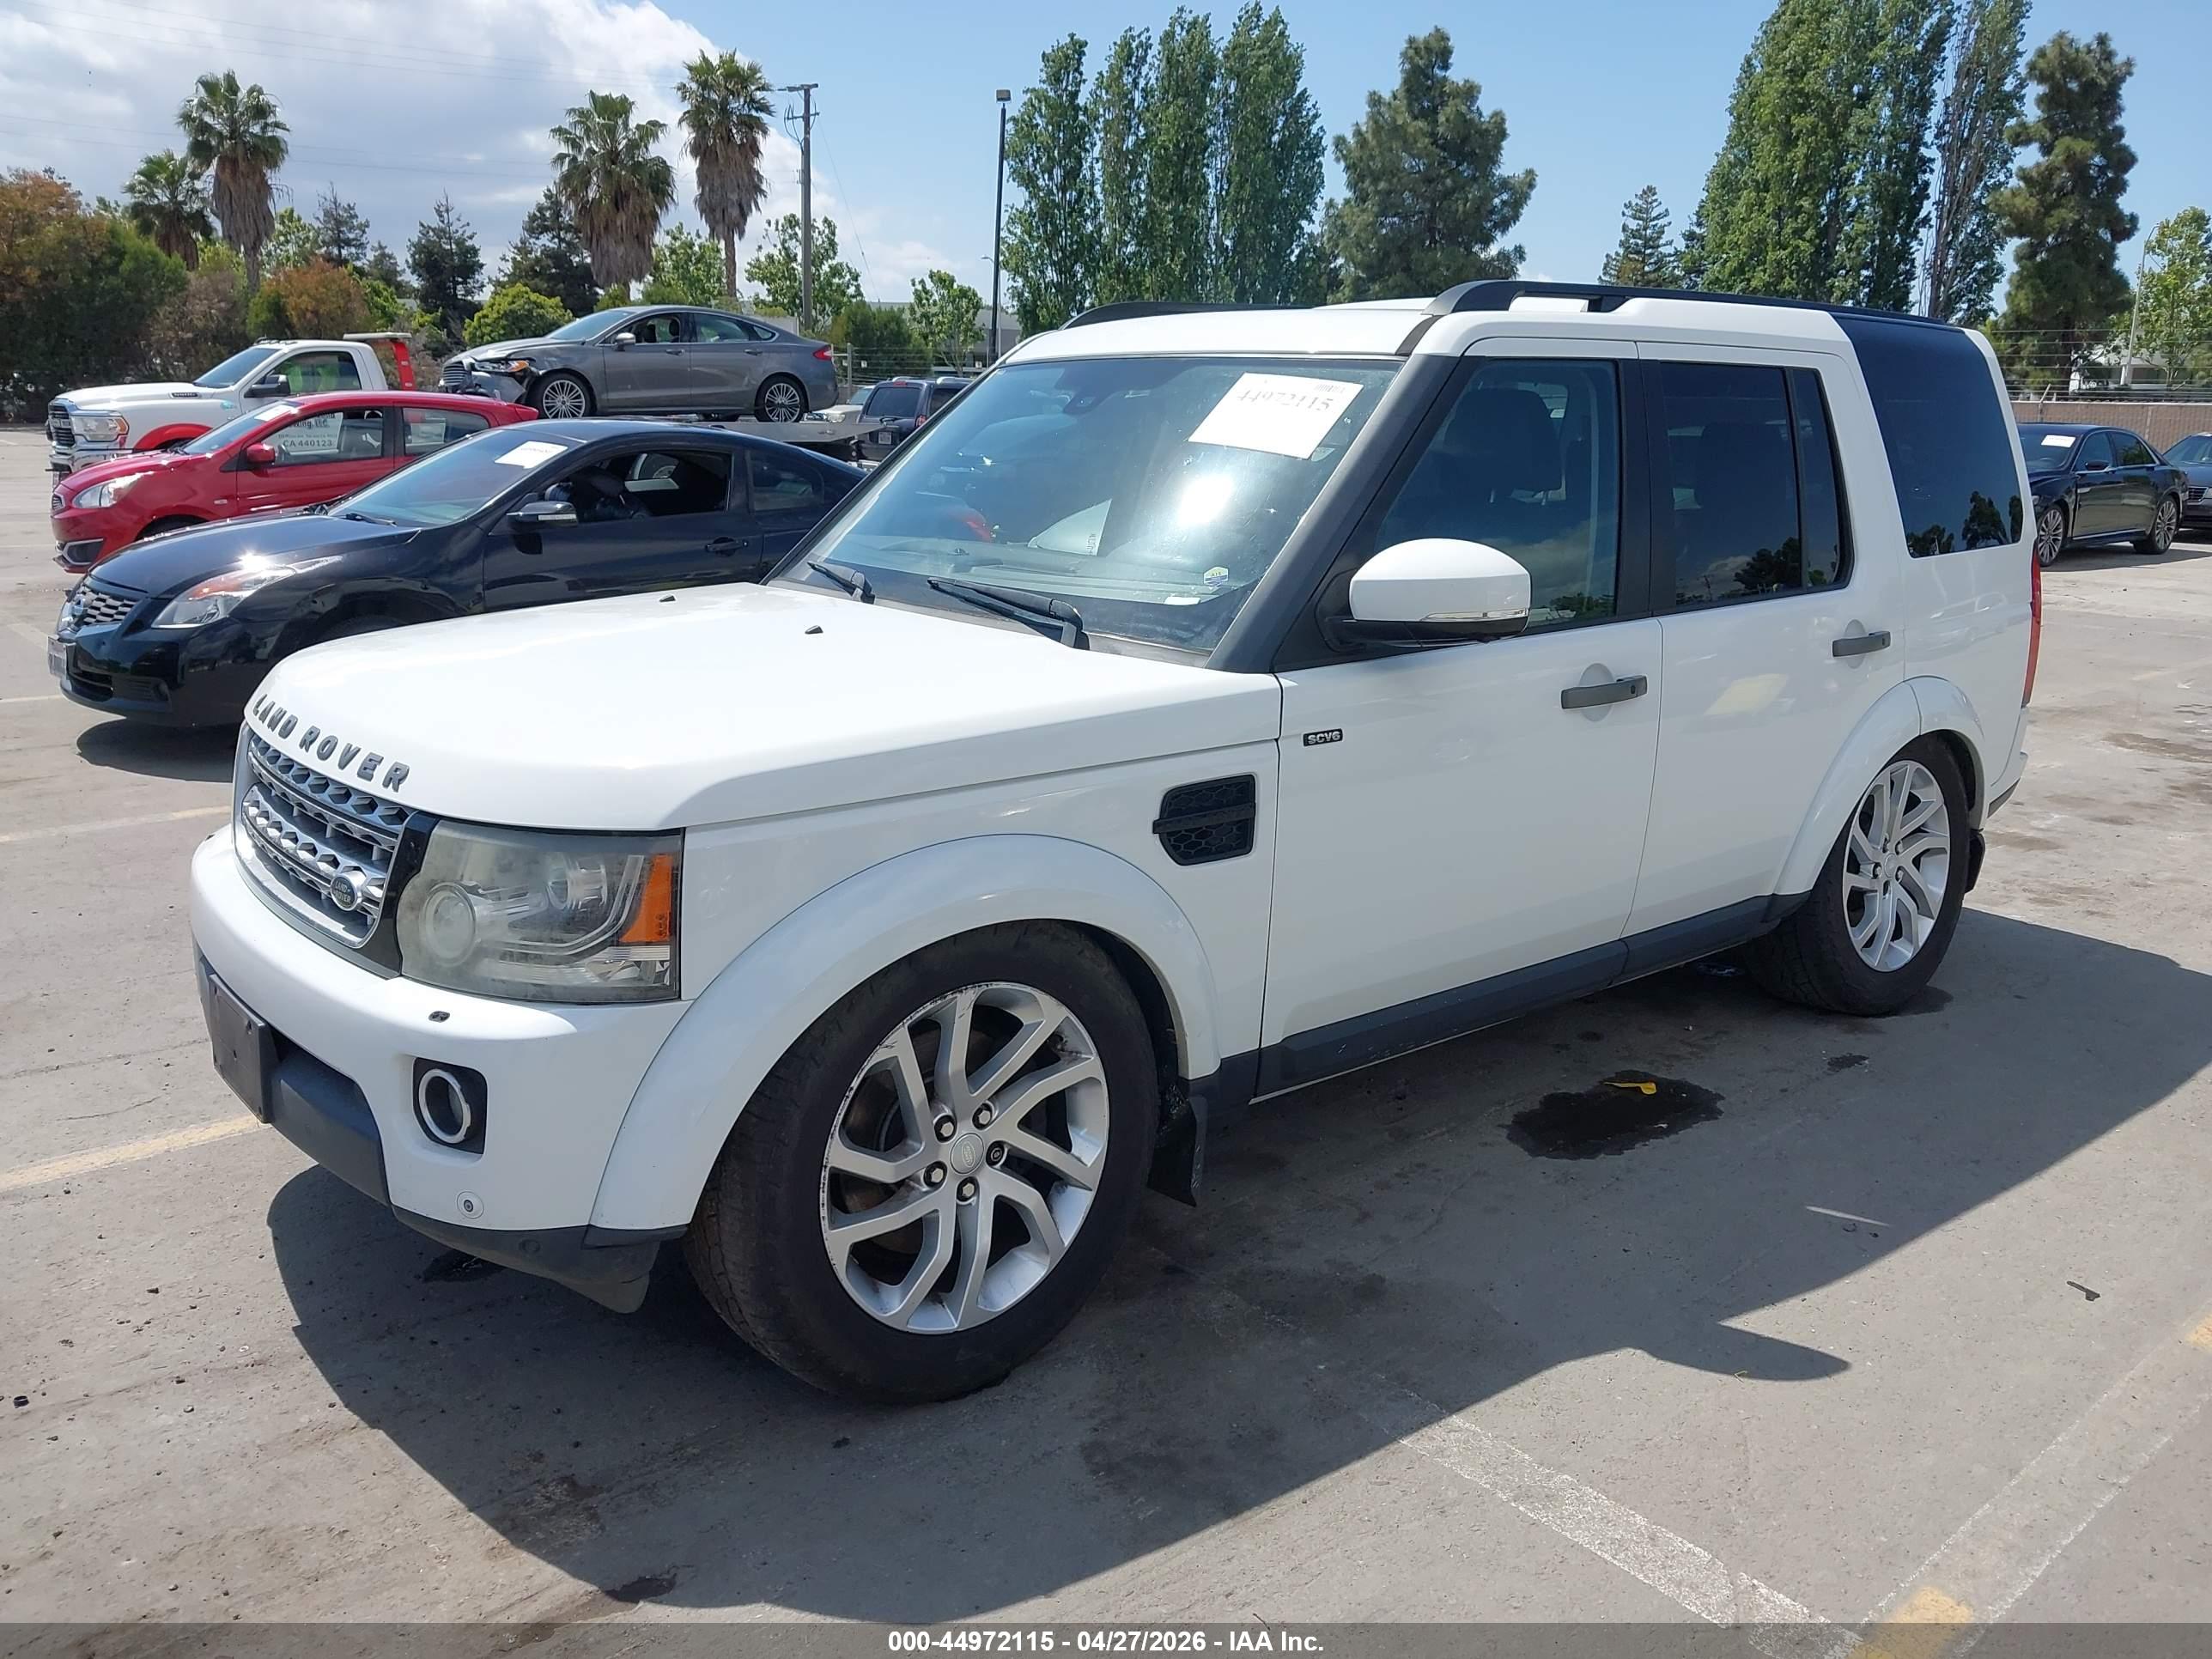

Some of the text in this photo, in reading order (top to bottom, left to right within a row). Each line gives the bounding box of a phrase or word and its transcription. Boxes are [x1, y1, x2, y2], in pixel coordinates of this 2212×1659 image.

[298, 439, 333, 447] 440123
[253, 694, 410, 793] LAND ROVER
[1308, 731, 1340, 744] SCV6
[335, 880, 347, 893] LAND
